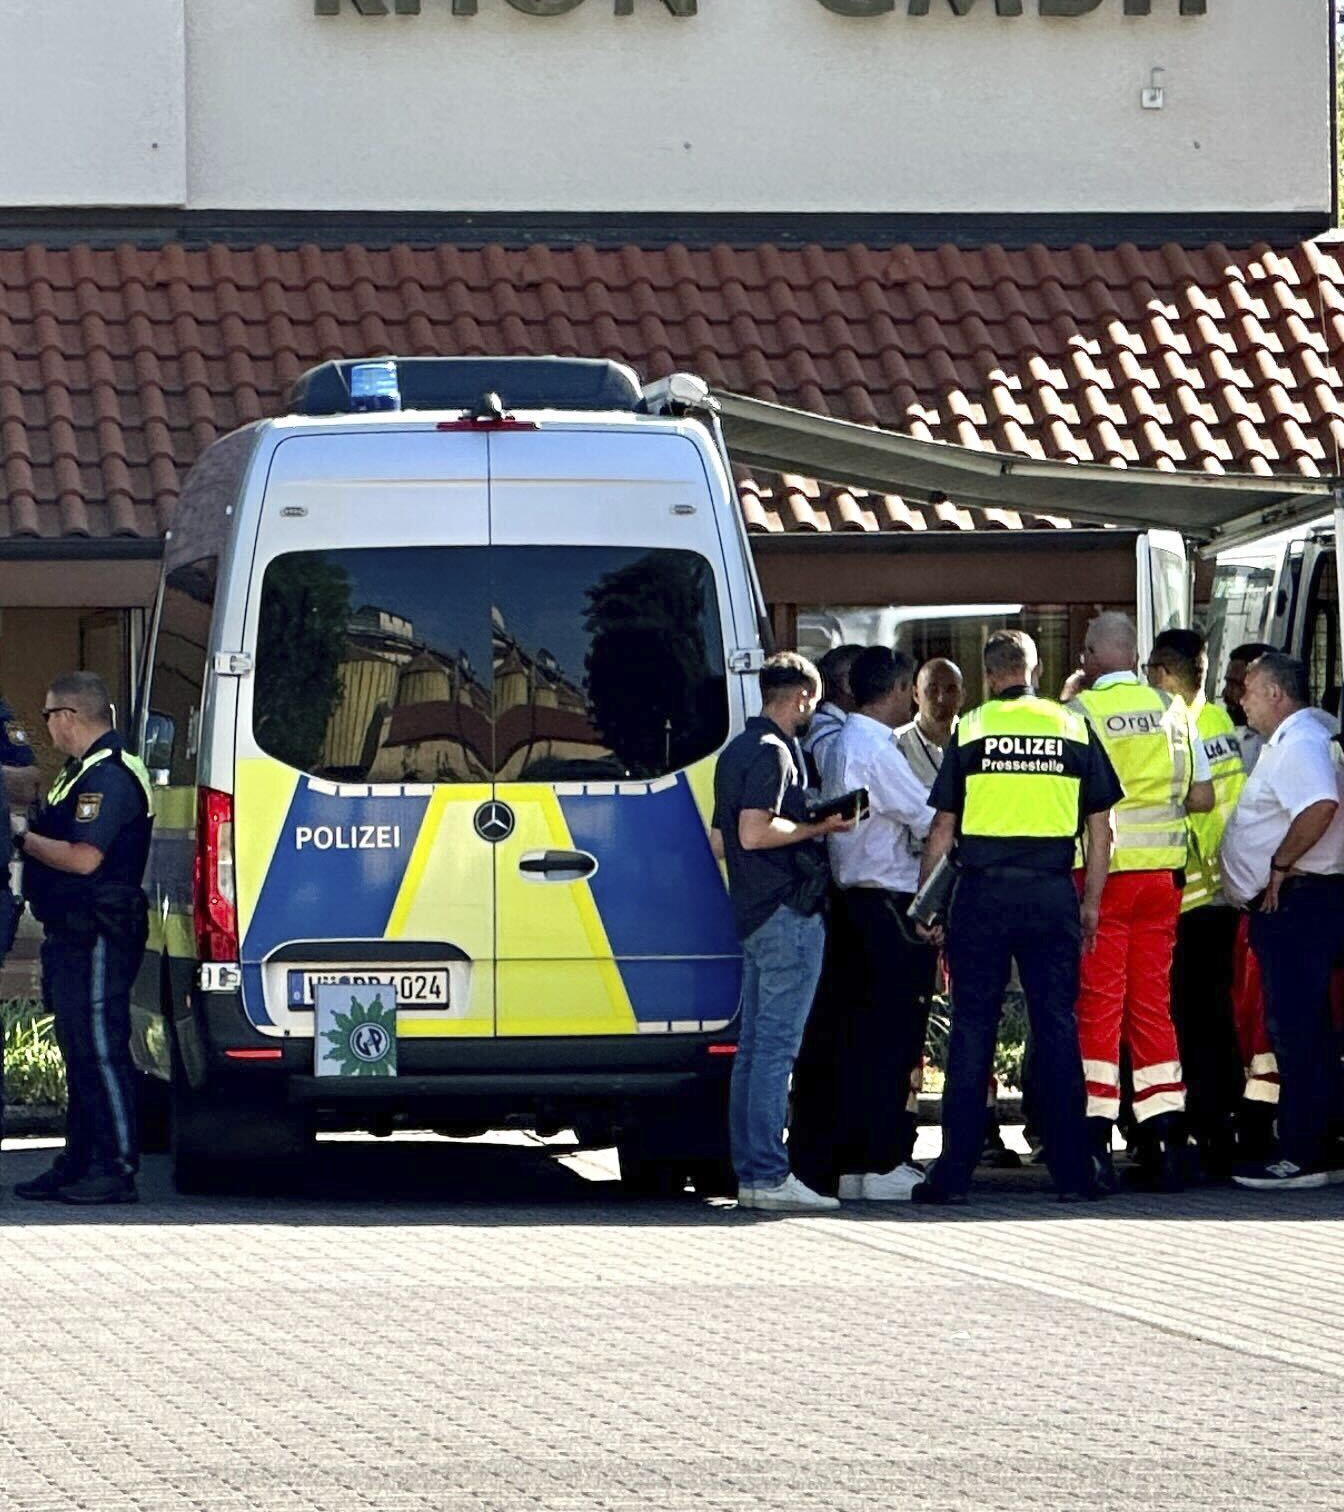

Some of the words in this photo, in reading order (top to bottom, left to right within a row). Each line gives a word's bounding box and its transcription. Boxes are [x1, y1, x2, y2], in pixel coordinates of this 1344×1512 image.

[984, 737, 1063, 756] POLIZEI
[981, 758, 1064, 773] Pressestelle
[296, 825, 400, 850] POLIZEI
